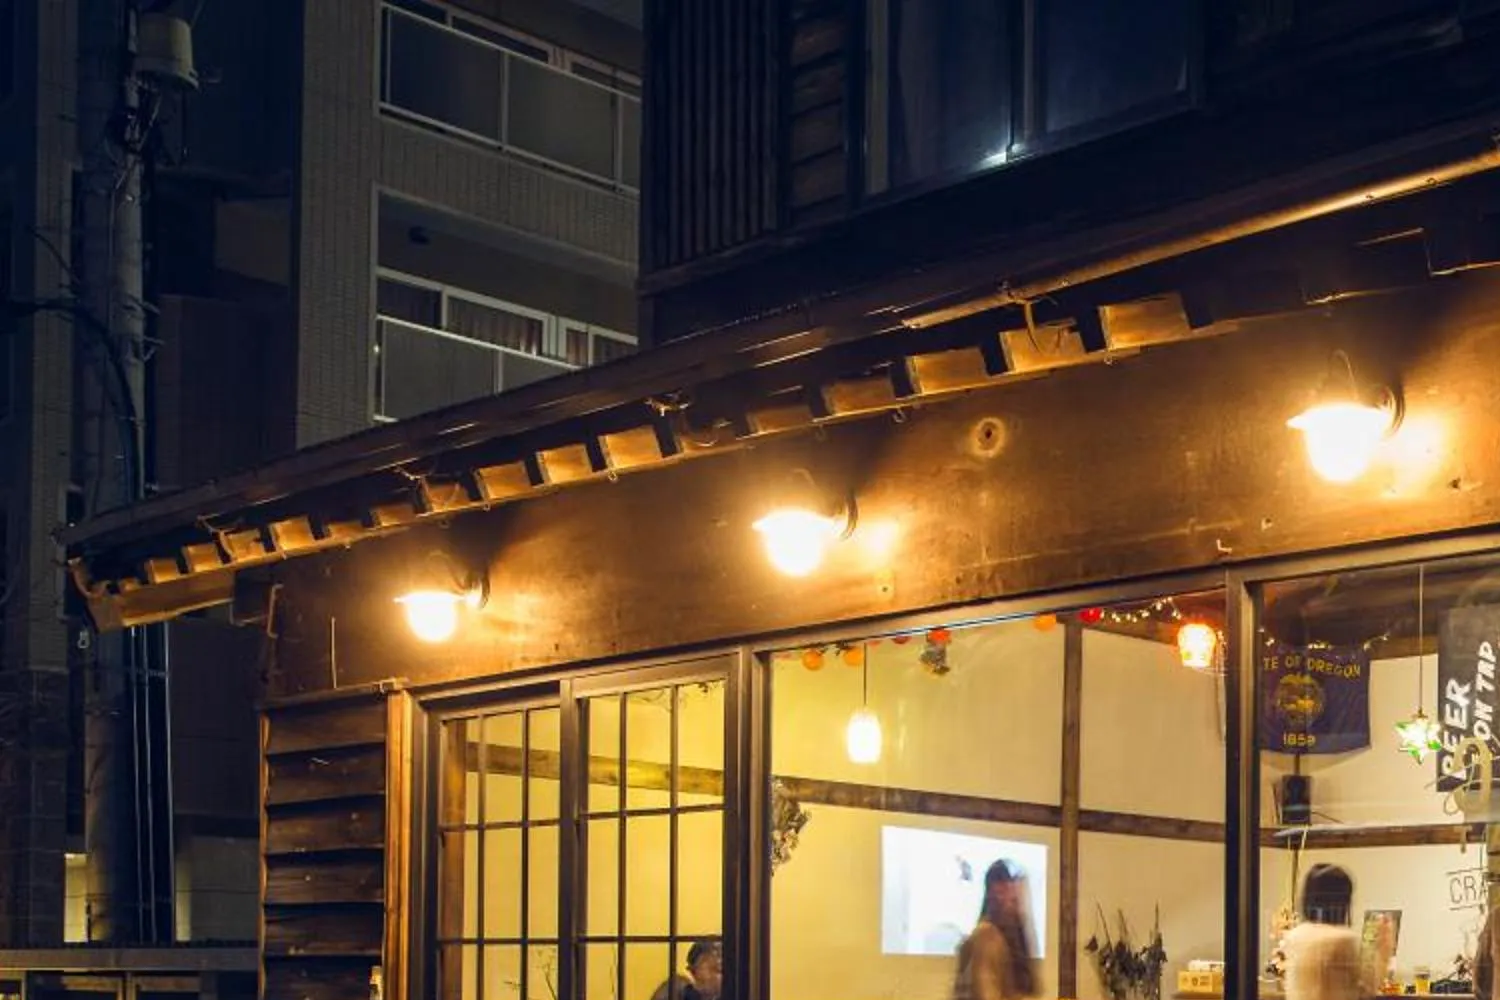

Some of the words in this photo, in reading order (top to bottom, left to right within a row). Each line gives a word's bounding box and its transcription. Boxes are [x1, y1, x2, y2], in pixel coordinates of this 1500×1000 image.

[1307, 658, 1361, 679] OREGON
[1475, 640, 1497, 692] TAP
[1442, 676, 1472, 780] BEER
[1472, 698, 1495, 742] ON
